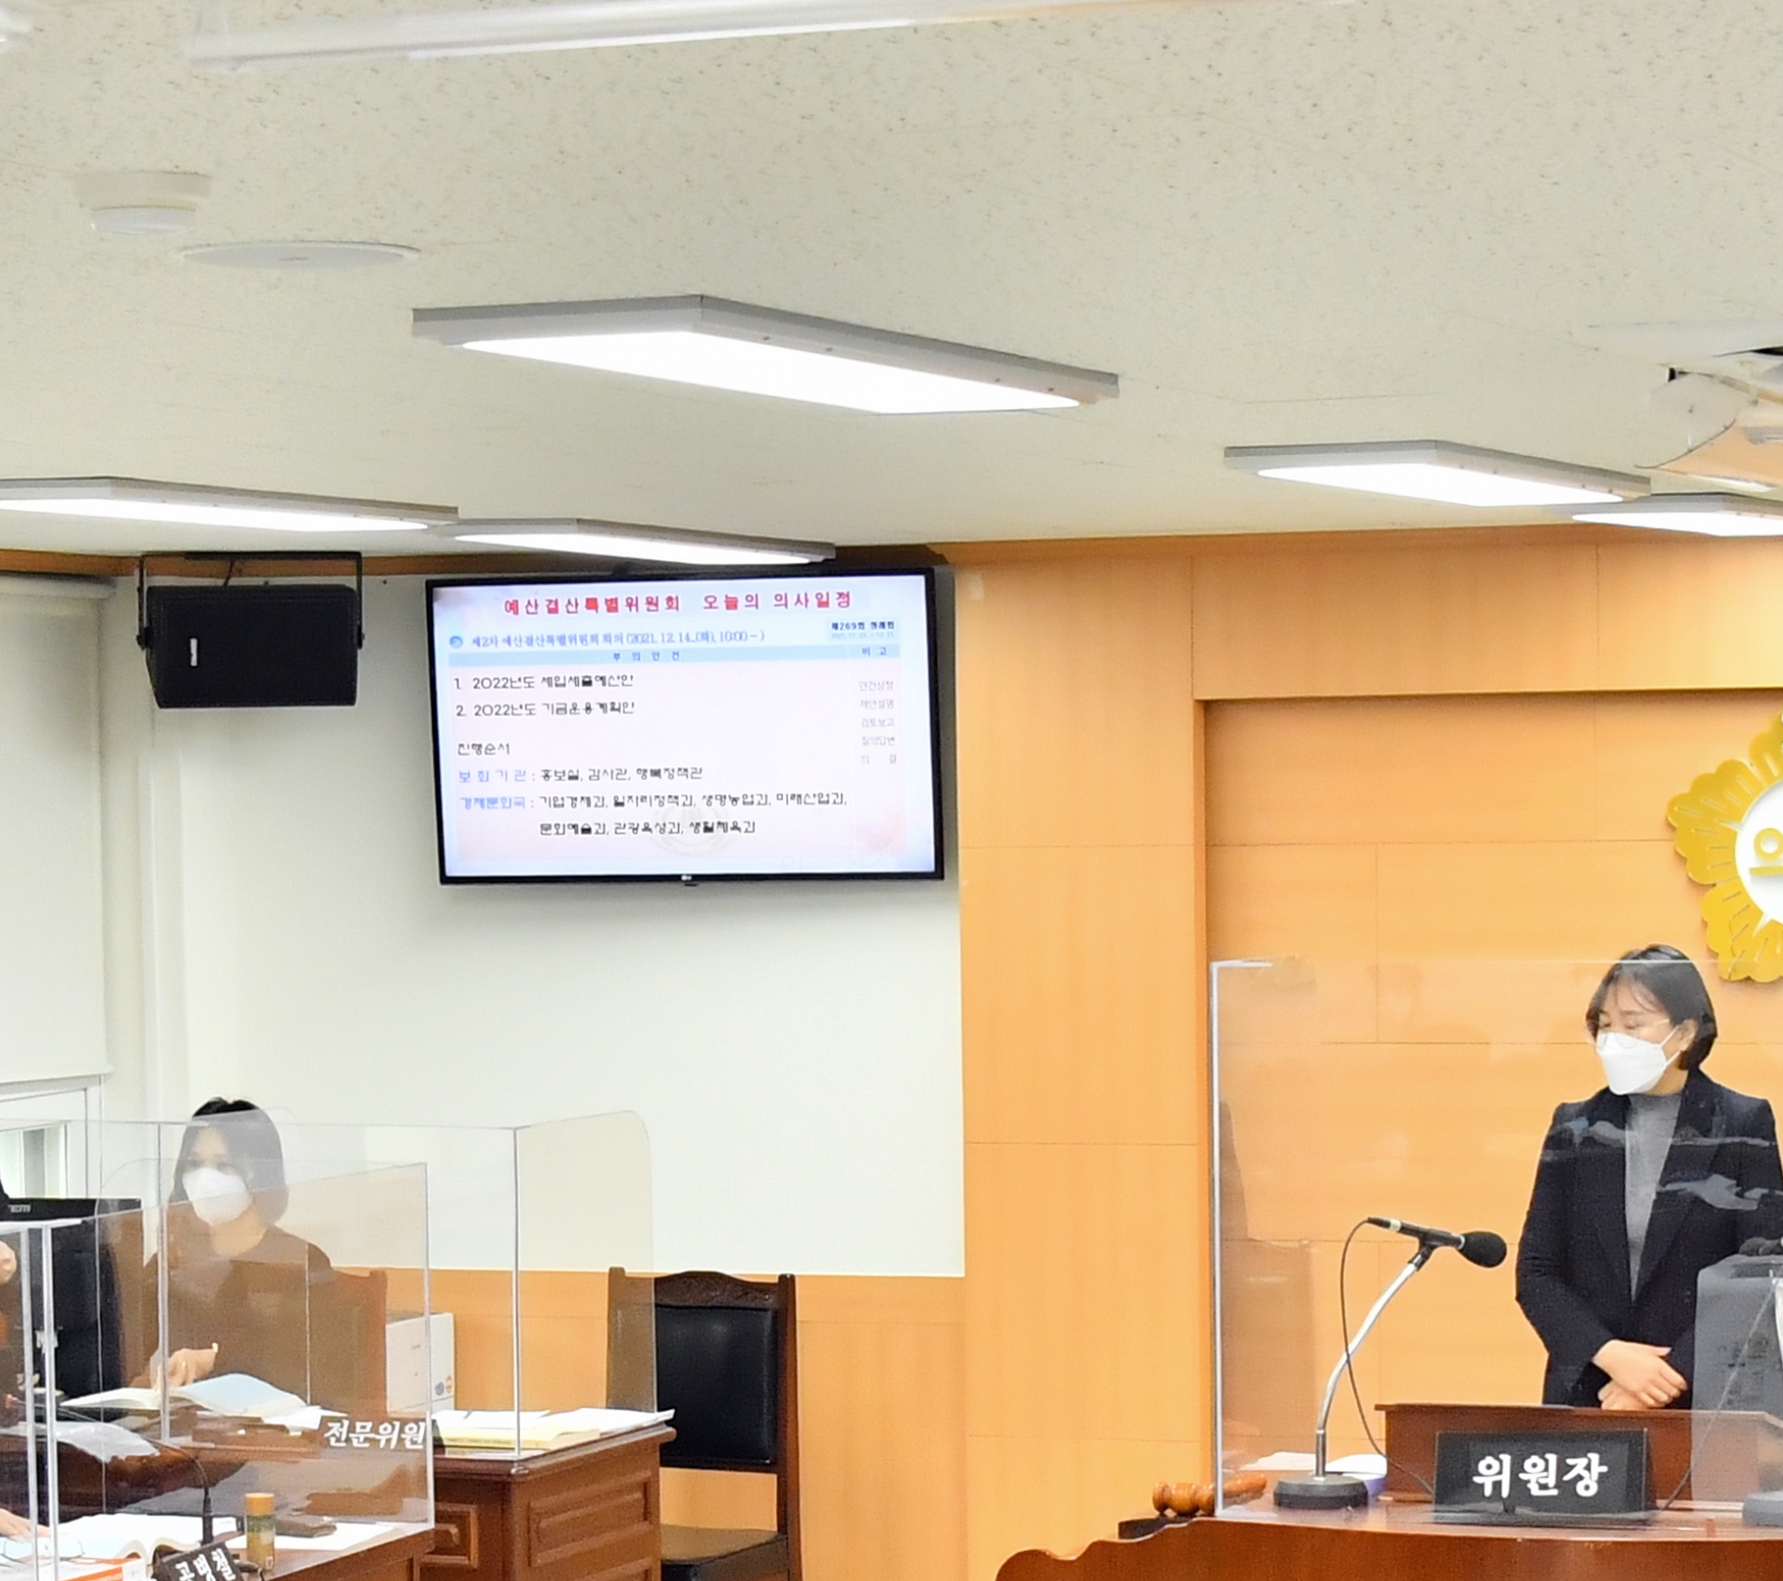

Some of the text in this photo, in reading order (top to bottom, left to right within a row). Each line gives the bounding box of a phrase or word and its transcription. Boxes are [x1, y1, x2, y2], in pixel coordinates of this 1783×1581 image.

[504, 591, 851, 616] 예산결산특별위원회 오늘의 의사일정
[472, 676, 535, 690] 2022년도
[474, 703, 536, 717] 2022년도
[324, 1419, 426, 1450] 전문위원
[1472, 1452, 1609, 1499] 위원장
